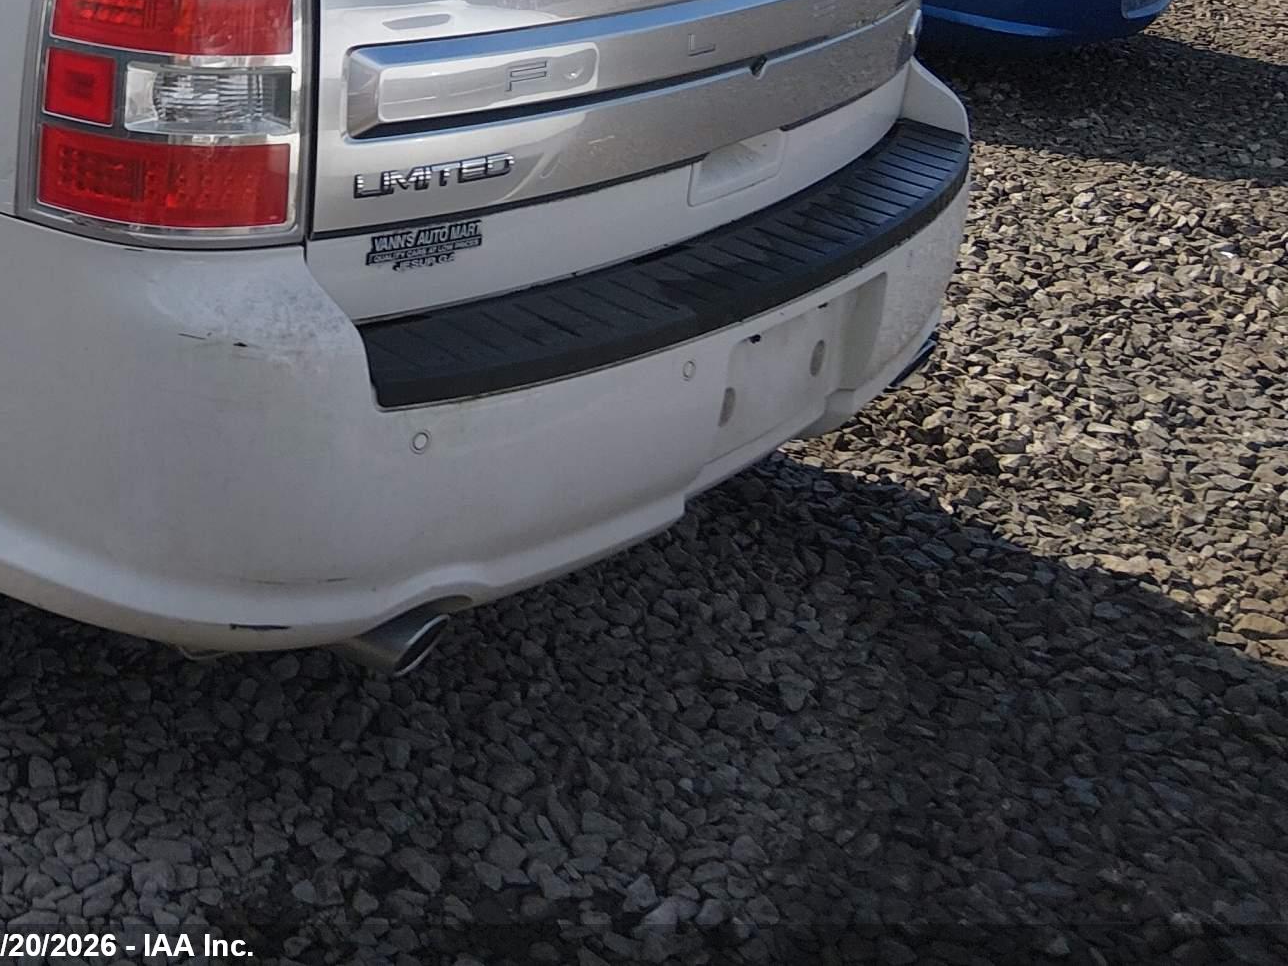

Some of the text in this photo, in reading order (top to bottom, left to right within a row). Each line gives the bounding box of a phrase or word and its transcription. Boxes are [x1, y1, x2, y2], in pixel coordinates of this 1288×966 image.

[354, 152, 514, 198] LIMITED
[417, 228, 448, 245] AUTO
[450, 222, 481, 240] MART
